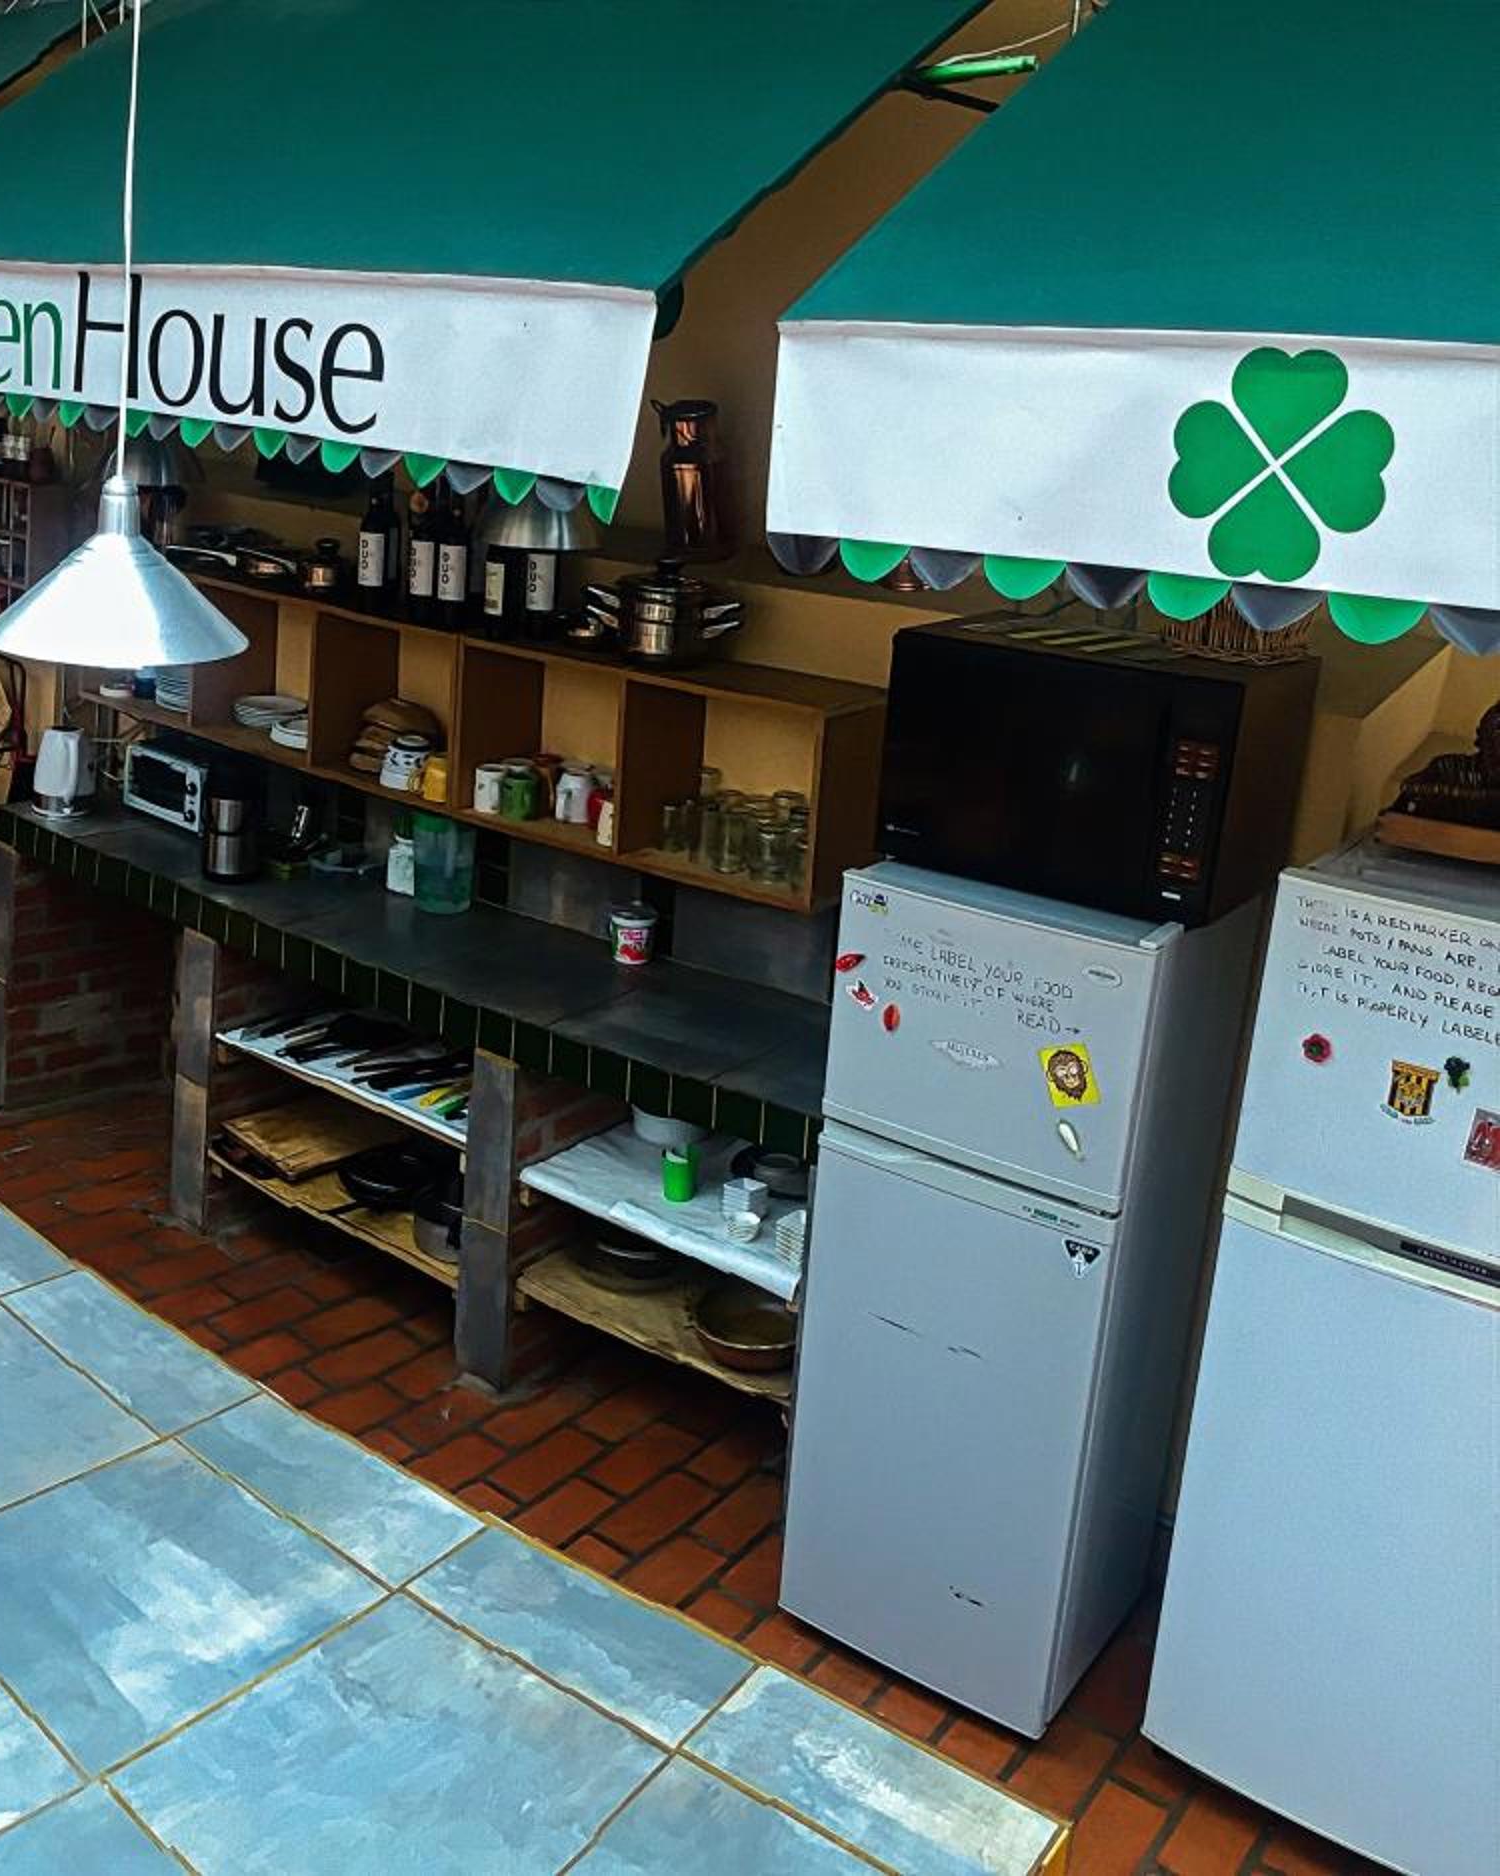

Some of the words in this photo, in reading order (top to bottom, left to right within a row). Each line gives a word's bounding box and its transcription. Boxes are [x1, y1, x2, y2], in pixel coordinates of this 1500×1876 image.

[1350, 926, 1381, 945] POTS
[1398, 939, 1434, 957] PANS
[1362, 912, 1373, 925] A
[1377, 915, 1411, 931] RED
[1412, 922, 1472, 947] MARKER
[931, 949, 976, 971] LABEL
[983, 961, 1024, 986] YOUR
[1322, 944, 1365, 964] LABEL
[1373, 955, 1410, 975] YOUR
[1391, 983, 1427, 1001] AND
[1433, 991, 1494, 1019] PLEASE
[1017, 1011, 1061, 1034] READ
